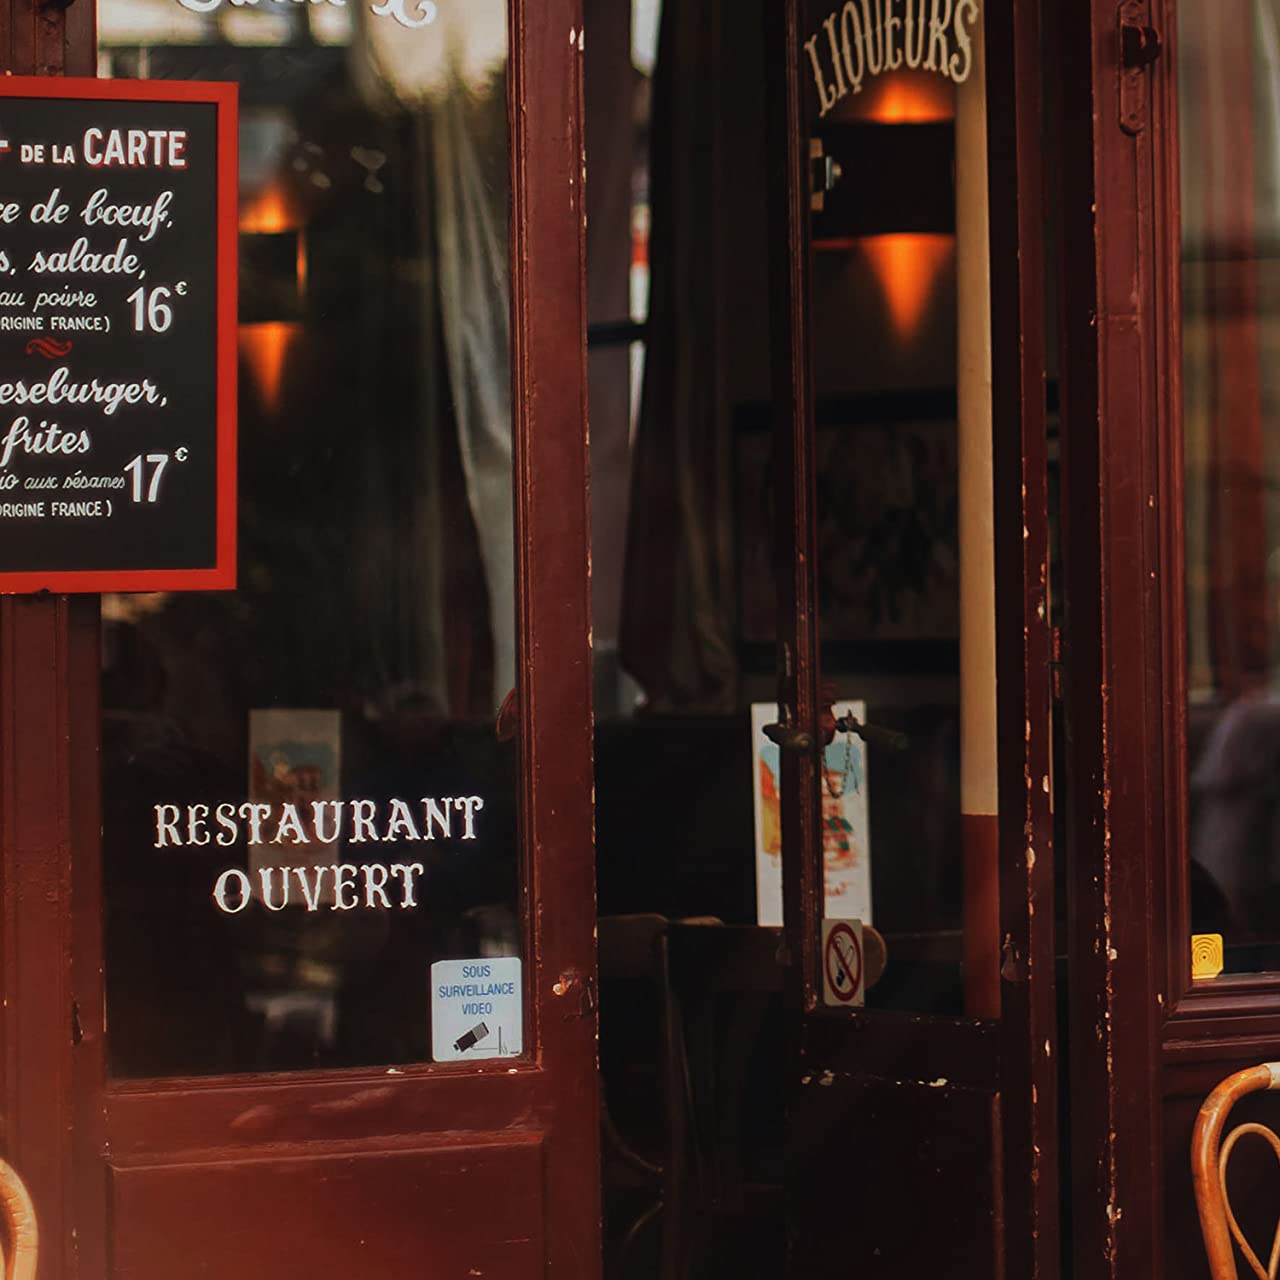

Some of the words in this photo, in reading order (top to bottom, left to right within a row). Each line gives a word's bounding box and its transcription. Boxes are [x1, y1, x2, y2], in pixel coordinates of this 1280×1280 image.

[20, 144, 45, 164] DE
[52, 144, 76, 164] LA
[84, 128, 187, 169] CARTE
[30, 188, 70, 223] de
[80, 188, 174, 241] bœuf,
[27, 237, 146, 279] salade,
[33, 285, 98, 312] poivre
[51, 315, 110, 333] FRANCE)
[0, 367, 168, 415] eseburger,
[0, 416, 90, 467] frites
[62, 470, 125, 489] sésames
[0, 503, 45, 517] RIGINE
[153, 796, 486, 849] RESTAURANT
[212, 863, 425, 913] OUVERT
[462, 965, 491, 978] SOUS
[438, 983, 514, 998] SURVEILLANCE
[462, 1002, 492, 1015] VIDEO
